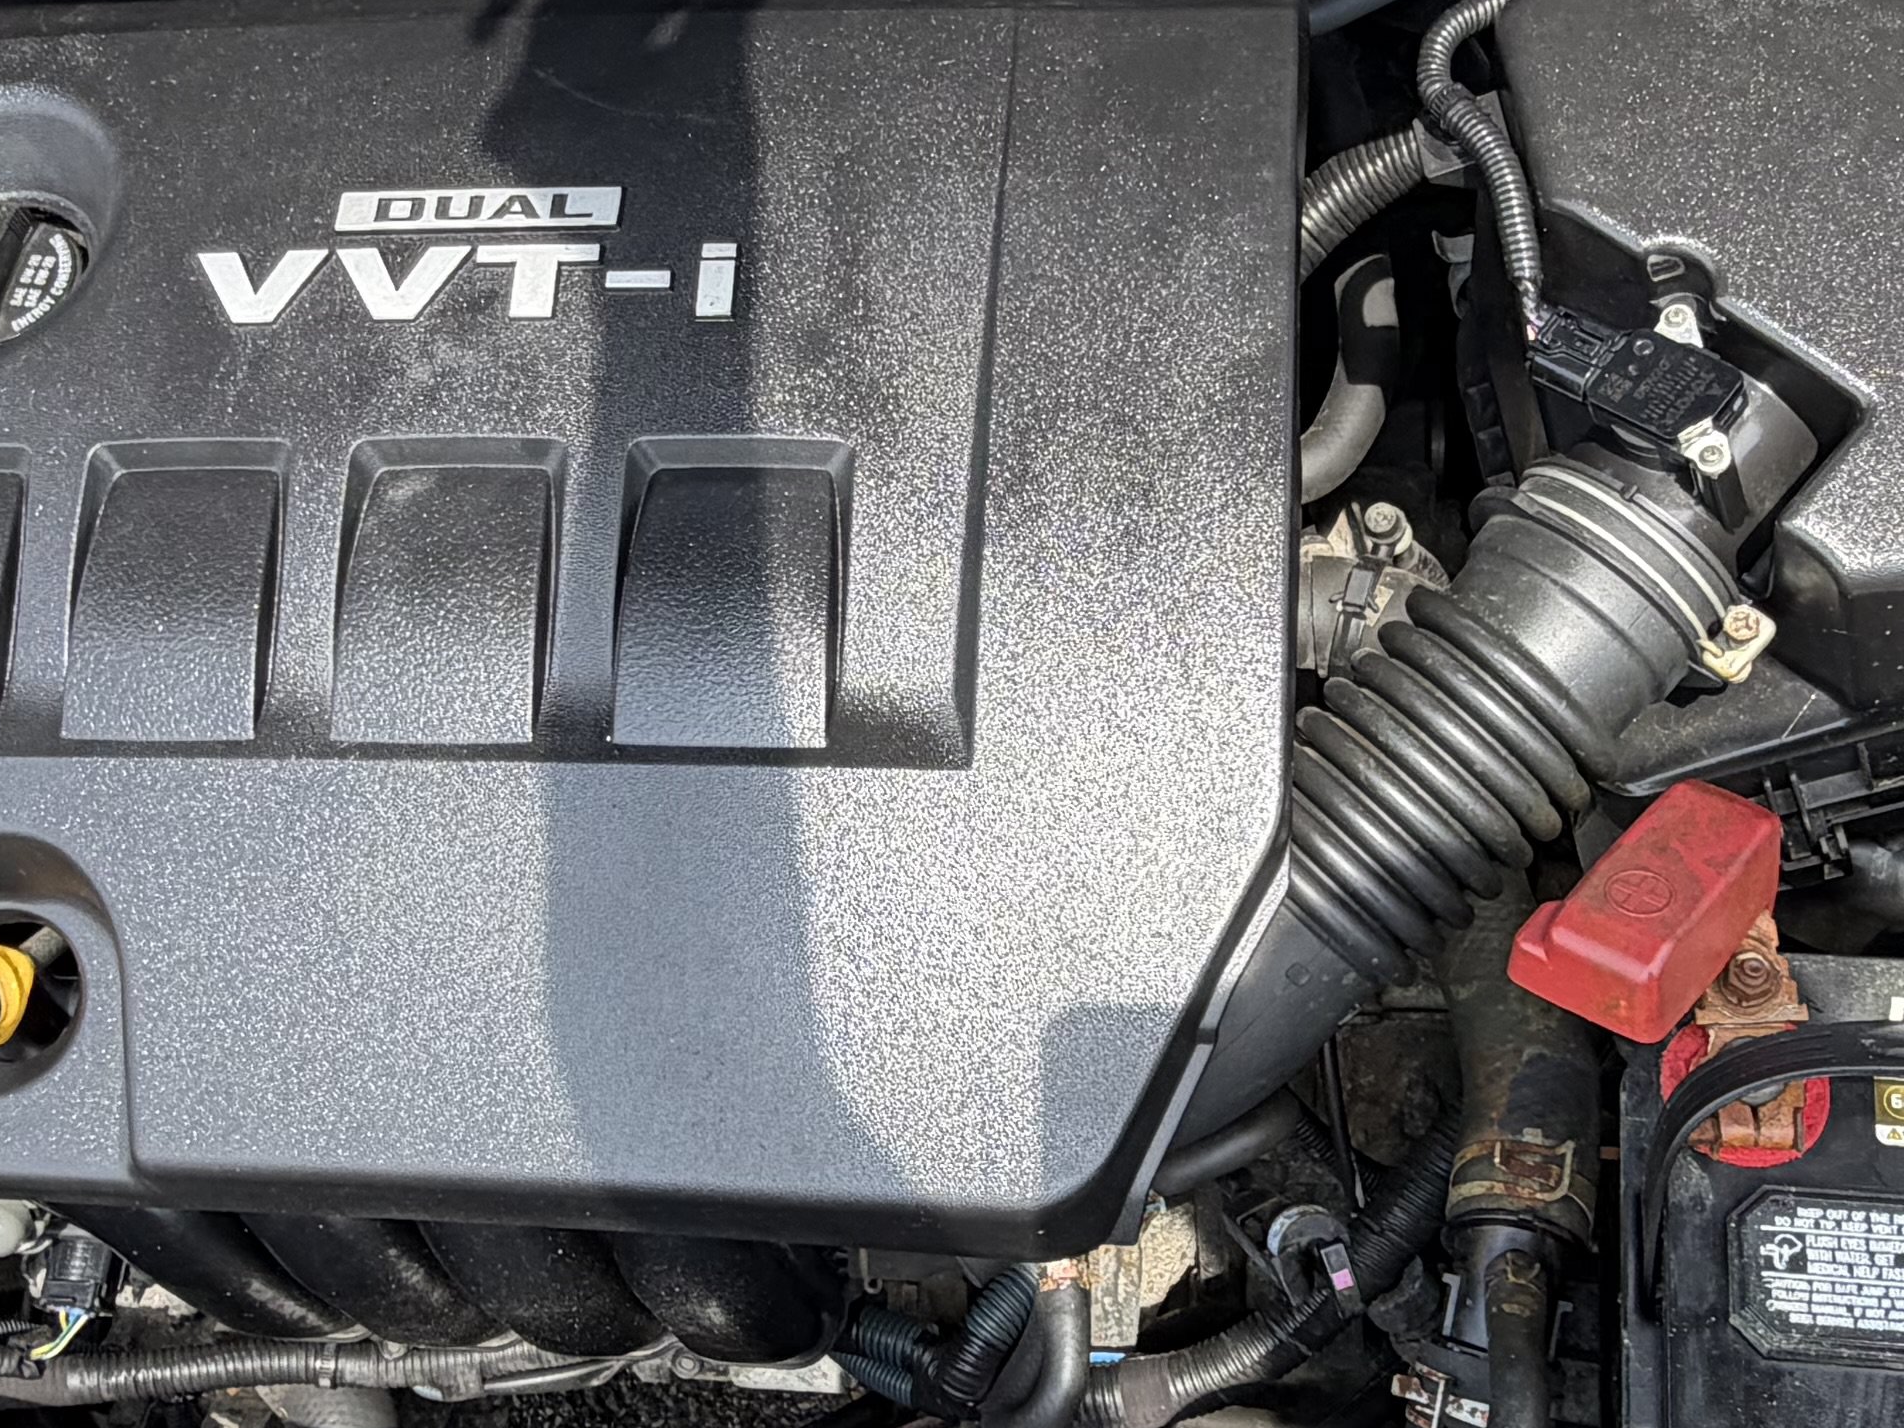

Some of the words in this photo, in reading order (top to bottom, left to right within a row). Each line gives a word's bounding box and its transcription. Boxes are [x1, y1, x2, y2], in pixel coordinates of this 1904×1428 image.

[373, 193, 593, 223] DUAL
[197, 243, 738, 323] VVT-i
[11, 295, 56, 332] ENERGY
[1774, 1216, 1792, 1227] DO
[1826, 1208, 1849, 1220] OUT
[1851, 1210, 1866, 1221] OF
[1869, 1212, 1890, 1224] THE
[1805, 1234, 1838, 1249] FLUSH
[1840, 1237, 1867, 1252] EYES
[1806, 1248, 1833, 1262] WITH
[1874, 1253, 1895, 1266] GET
[1807, 1261, 1851, 1277] MEDICAL
[1853, 1264, 1880, 1278] HELP
